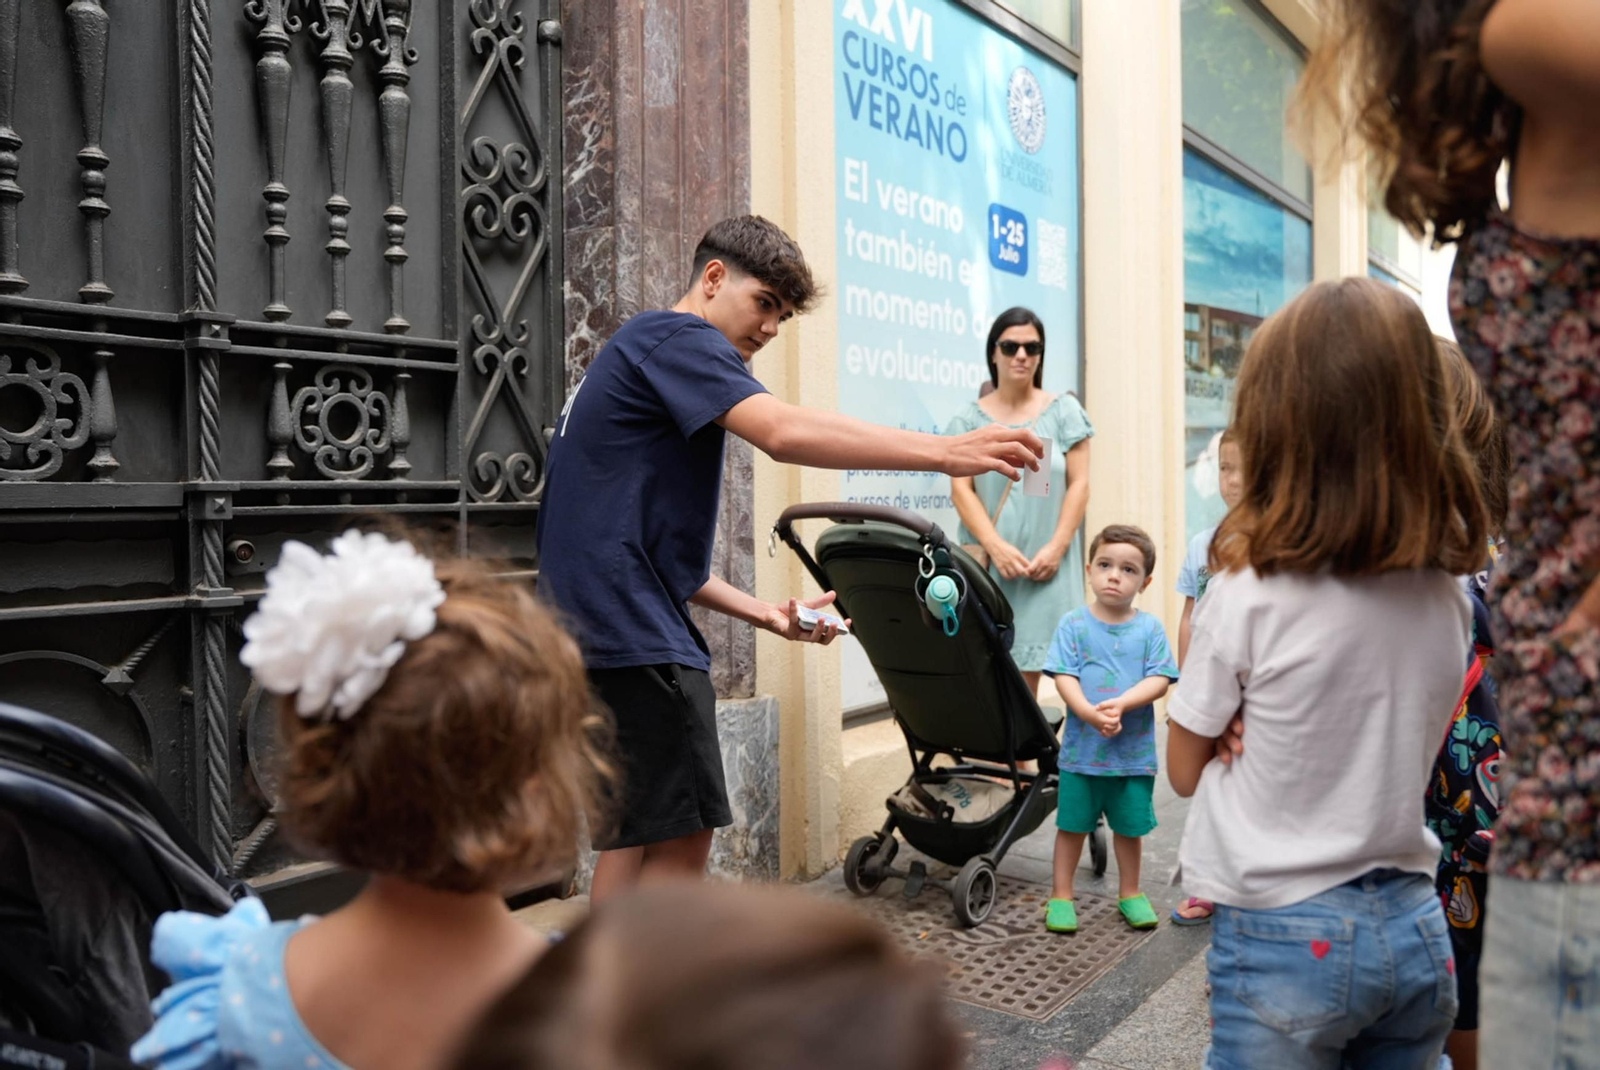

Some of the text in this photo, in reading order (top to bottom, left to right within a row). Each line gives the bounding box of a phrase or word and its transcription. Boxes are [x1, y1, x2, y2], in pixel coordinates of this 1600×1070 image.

[842, 30, 966, 117] CURSOS de
[842, 71, 967, 163] VERANO
[844, 157, 964, 233] El verano
[845, 218, 953, 282] también
[992, 213, 1025, 247] 1-25
[998, 243, 1020, 264] Julio
[845, 284, 966, 335] momento
[894, 489, 911, 510] de
